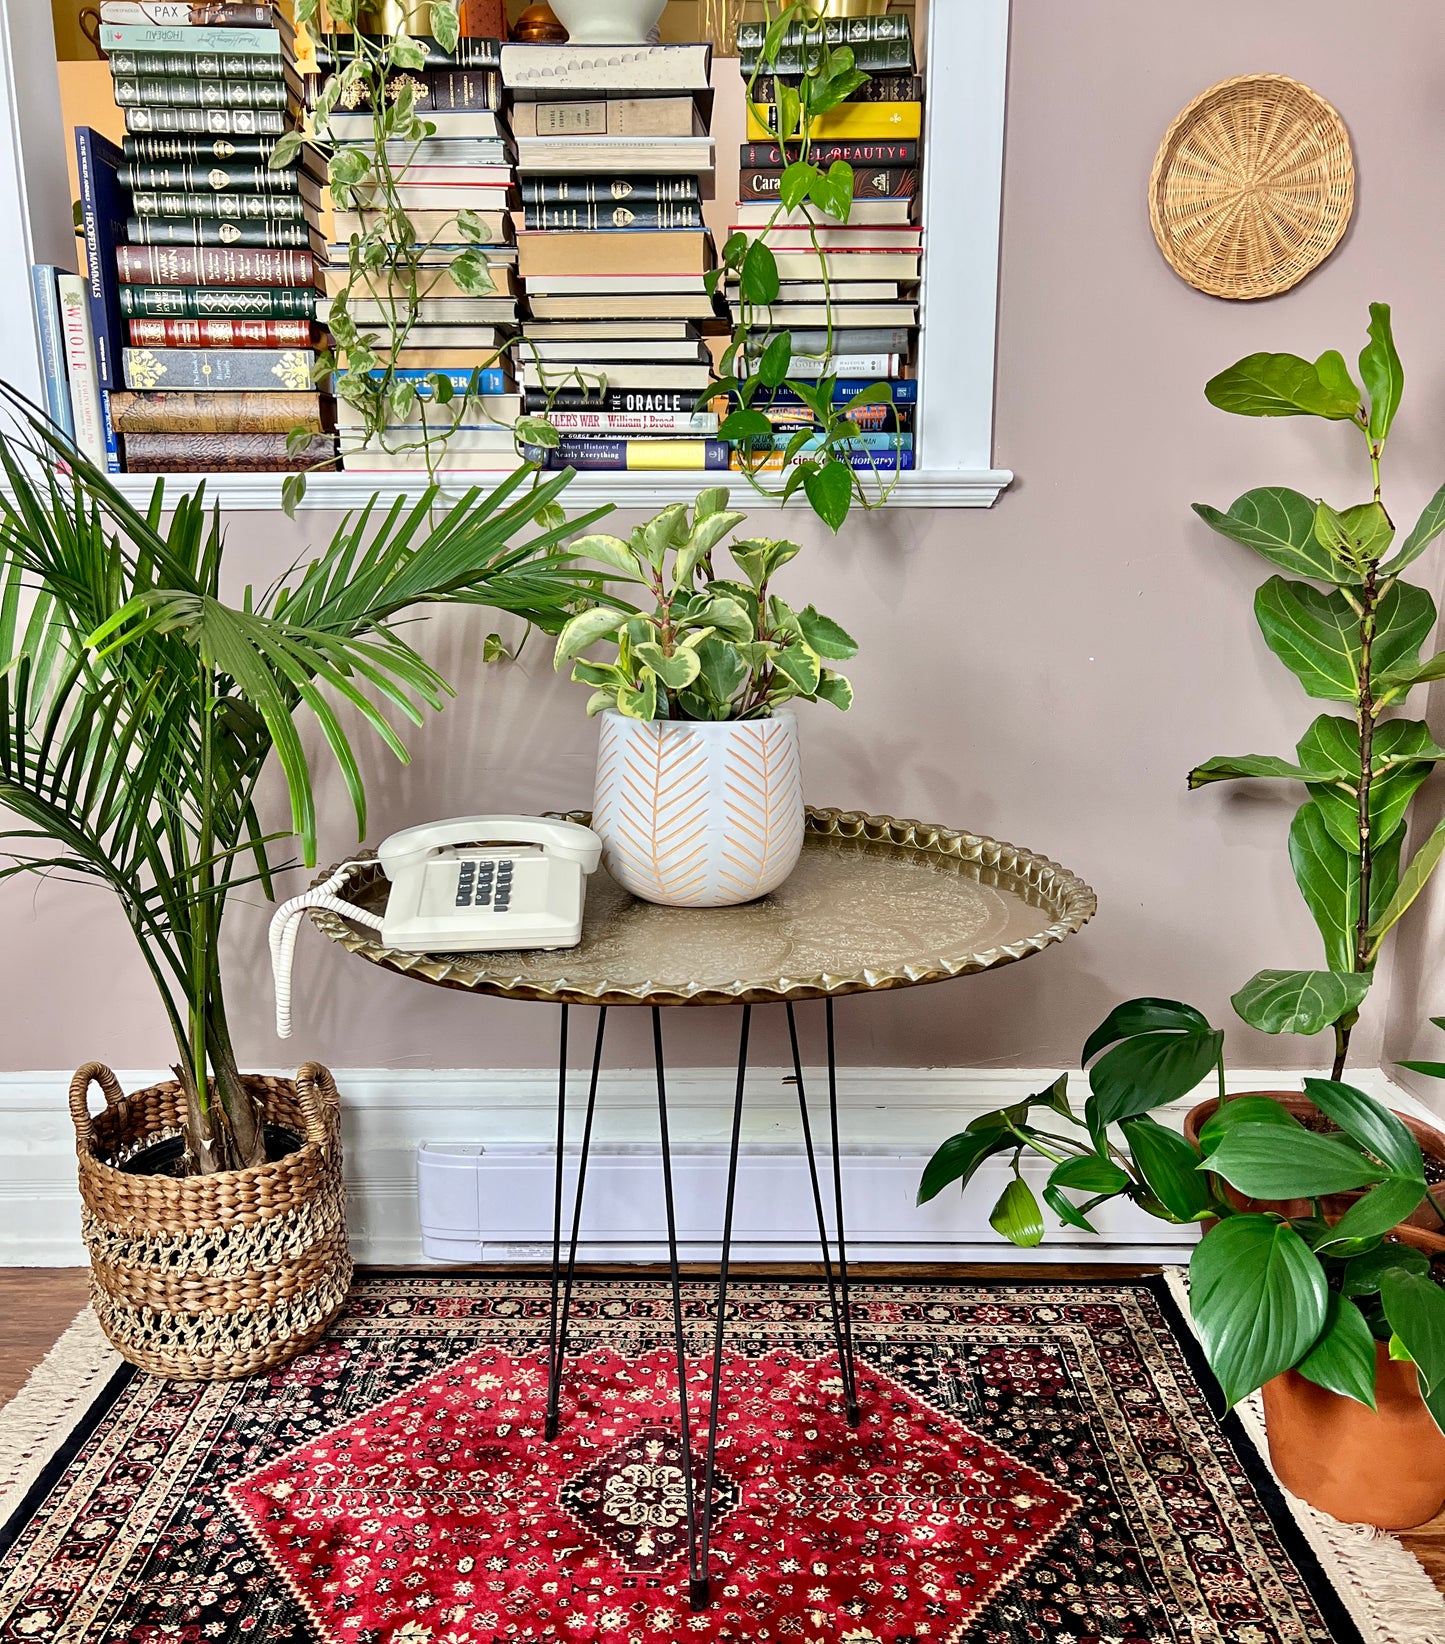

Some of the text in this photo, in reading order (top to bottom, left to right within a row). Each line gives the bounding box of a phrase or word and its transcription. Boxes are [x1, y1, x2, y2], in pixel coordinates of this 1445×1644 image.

[154, 5, 178, 17] PAX
[137, 30, 184, 41] THOREAU
[826, 147, 896, 162] BEAUTY
[85, 212, 101, 298] HOOFED MAMMALS
[160, 253, 170, 278] MARK
[168, 249, 180, 281] TWAIN
[154, 292, 164, 312] JANE
[162, 292, 170, 312] EYRE
[66, 307, 88, 371] WHOLE
[44, 323, 55, 378] AUSTRALIA
[612, 394, 621, 410] THE
[626, 394, 681, 411] ORACLE
[579, 414, 600, 427] WAR
[608, 414, 675, 429] William J. Broad
[562, 442, 620, 452] Short History of
[554, 451, 620, 460] Nearly Everything
